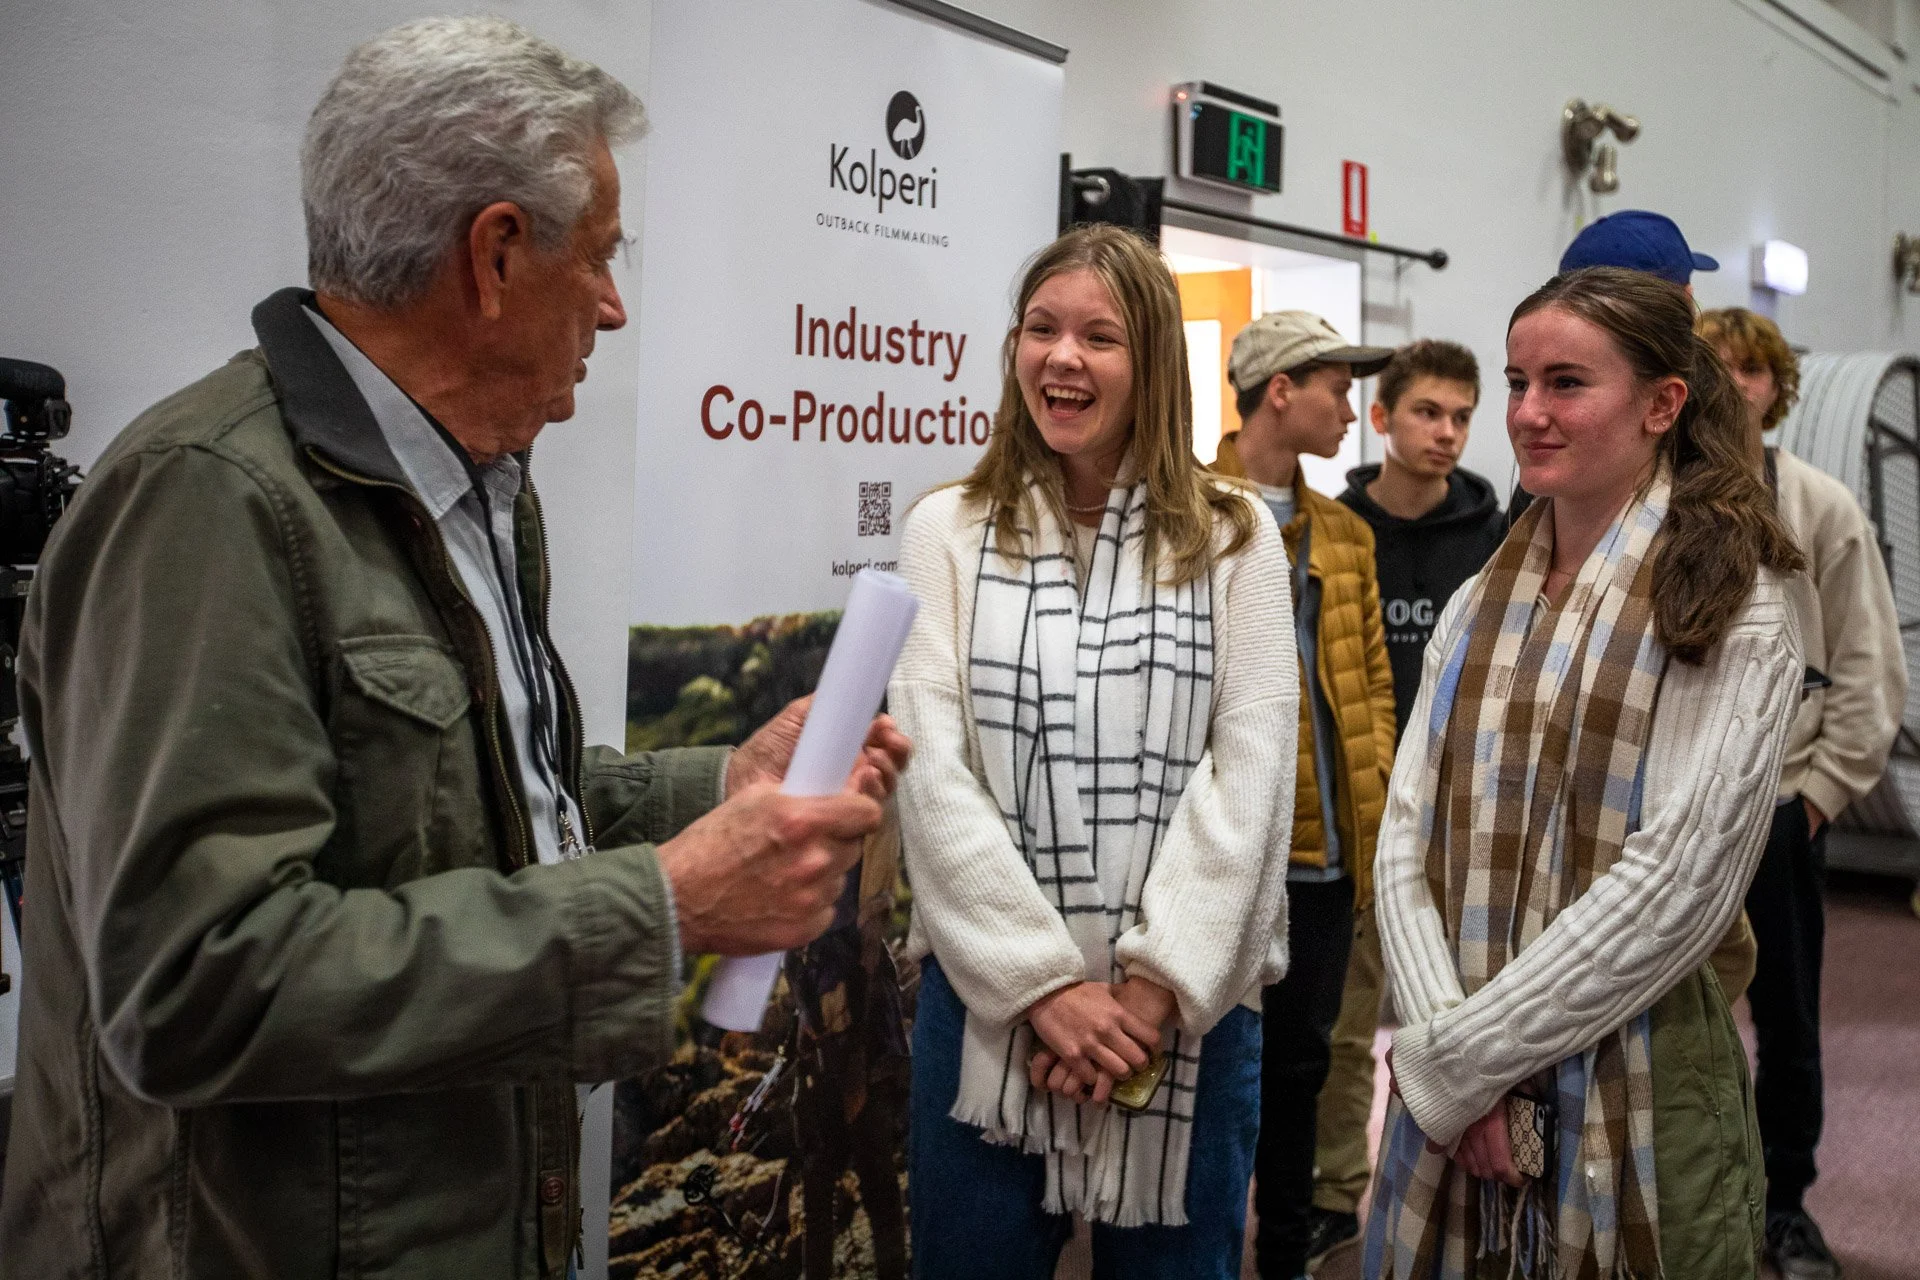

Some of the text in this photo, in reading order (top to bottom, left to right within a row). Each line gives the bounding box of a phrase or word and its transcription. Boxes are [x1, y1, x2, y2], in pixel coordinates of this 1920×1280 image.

[830, 143, 937, 213] Kolperi
[816, 212, 949, 247] OUTBACK FILMMAKING
[795, 303, 968, 382] Industry
[701, 384, 994, 446] Co-Productio
[832, 558, 898, 578] kolpericom
